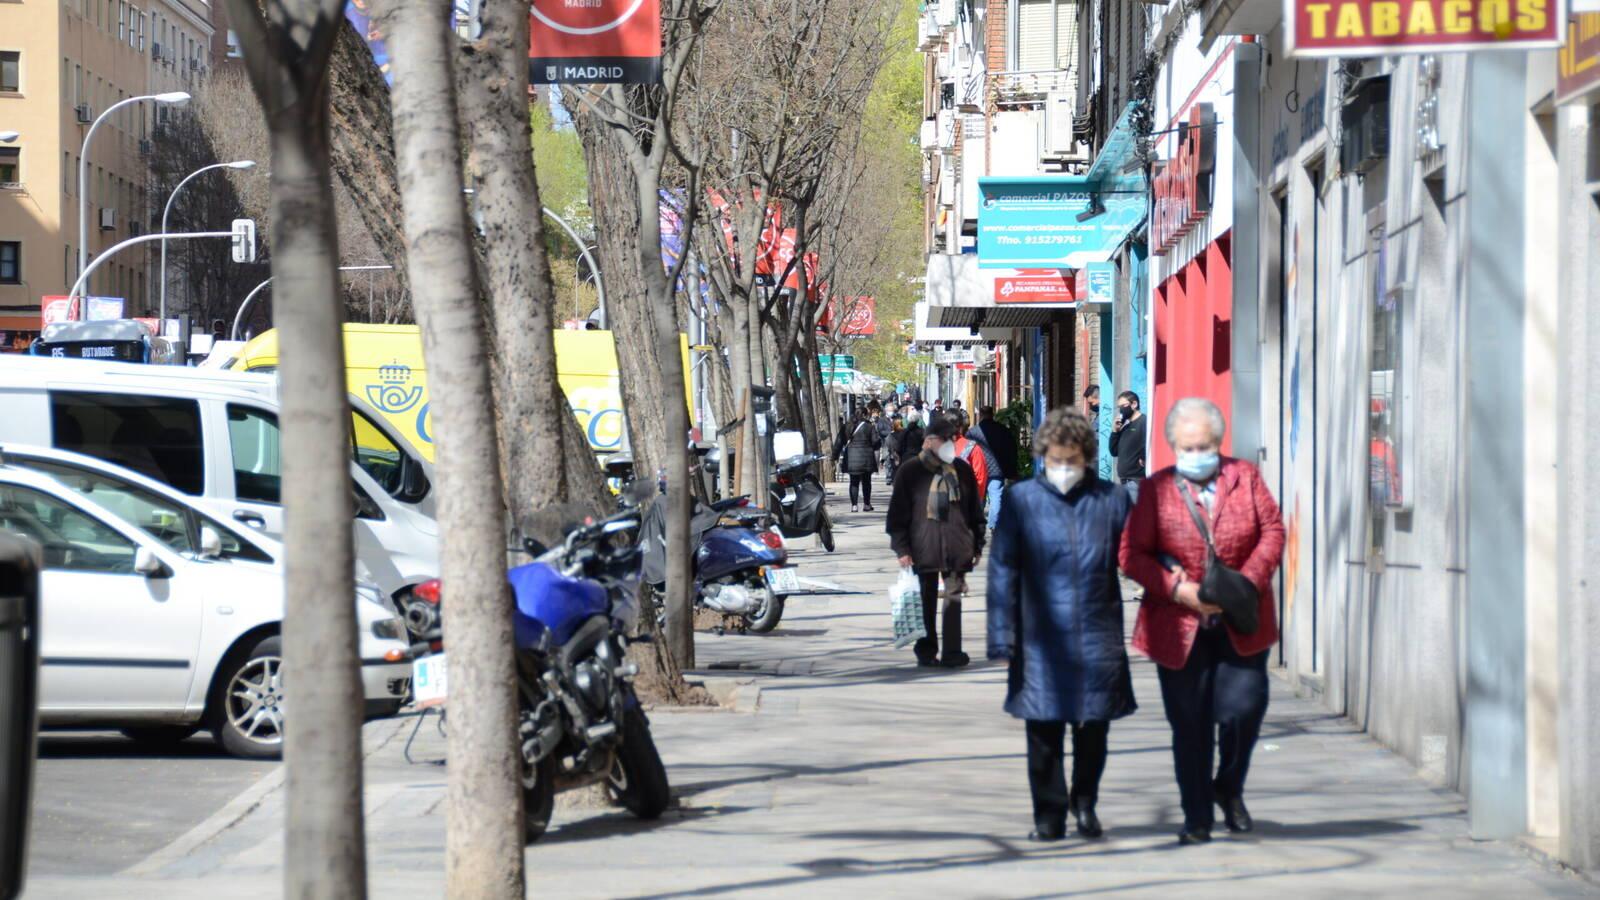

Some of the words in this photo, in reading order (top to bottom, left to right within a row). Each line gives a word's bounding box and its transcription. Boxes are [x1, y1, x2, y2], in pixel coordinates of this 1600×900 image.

[564, 0, 602, 8] MADRID
[1306, 0, 1548, 39] TABACOS
[564, 66, 624, 79] MADRID
[1000, 192, 1050, 203] comercial
[1053, 192, 1091, 202] PAZOS
